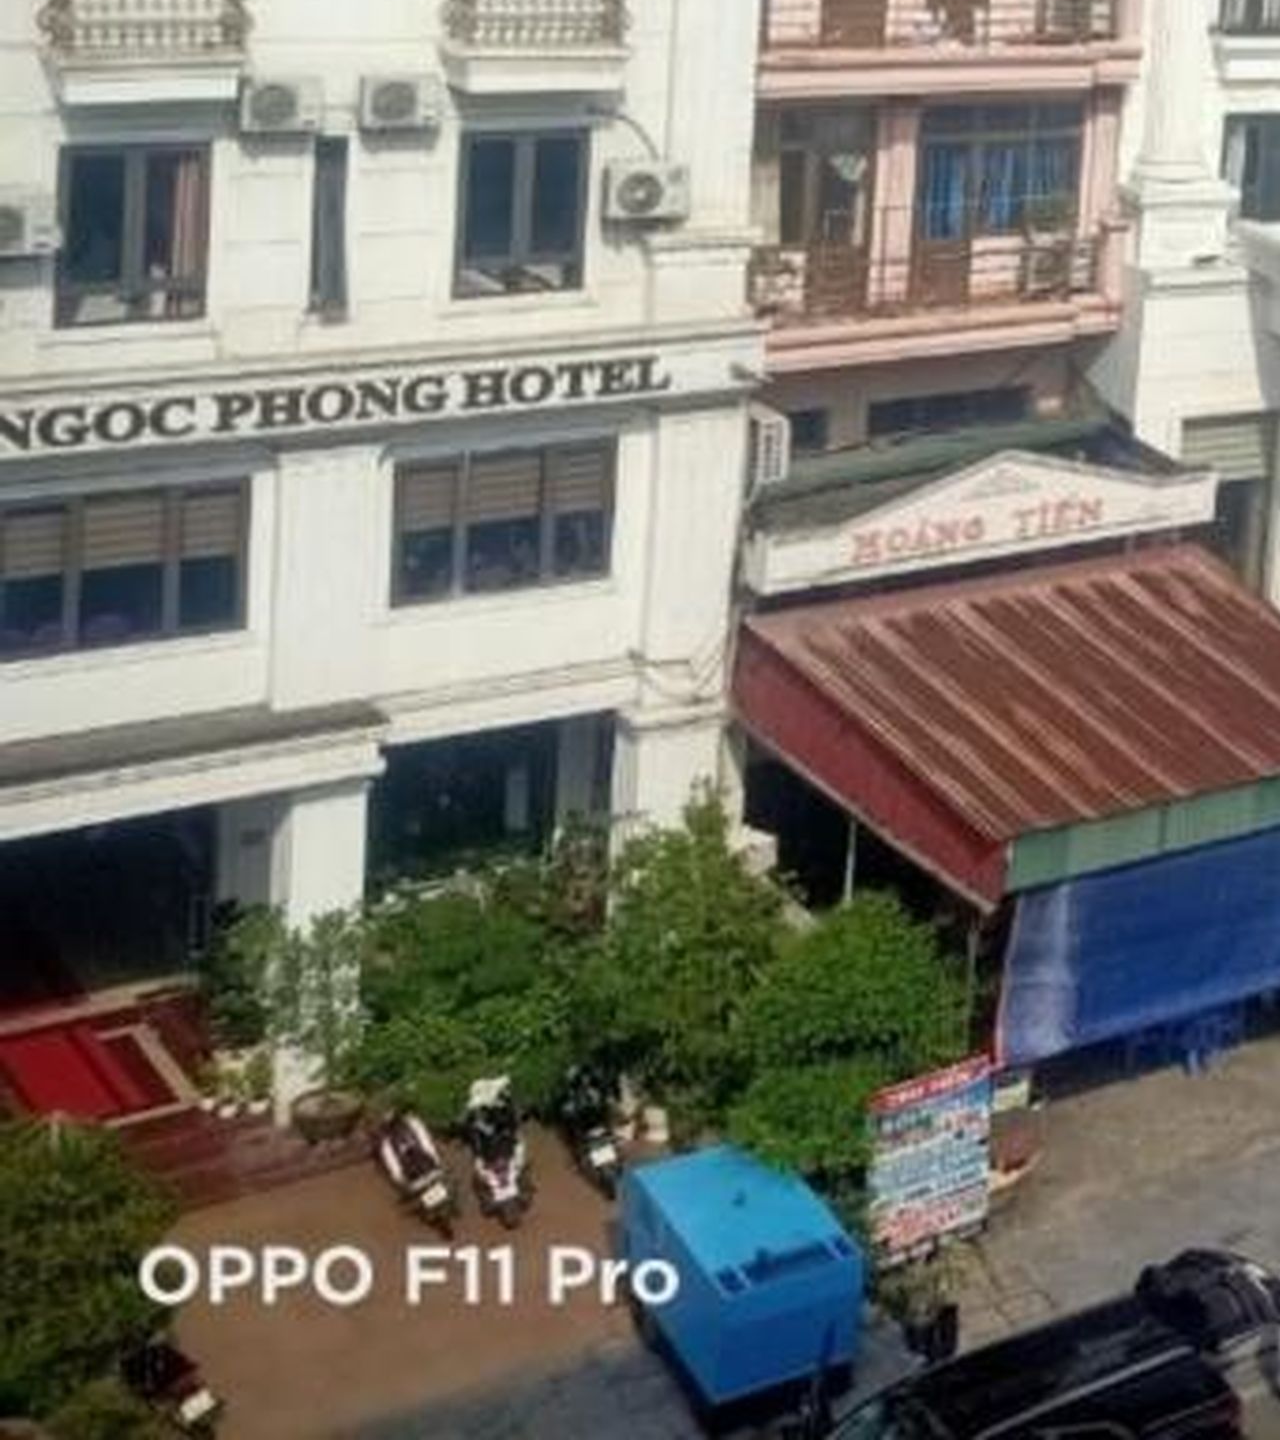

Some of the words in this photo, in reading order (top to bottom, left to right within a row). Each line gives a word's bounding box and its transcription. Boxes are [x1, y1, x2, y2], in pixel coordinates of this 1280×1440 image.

[0, 397, 197, 450] NGOC
[210, 371, 450, 433] PHONG
[461, 356, 670, 410] HOTEL
